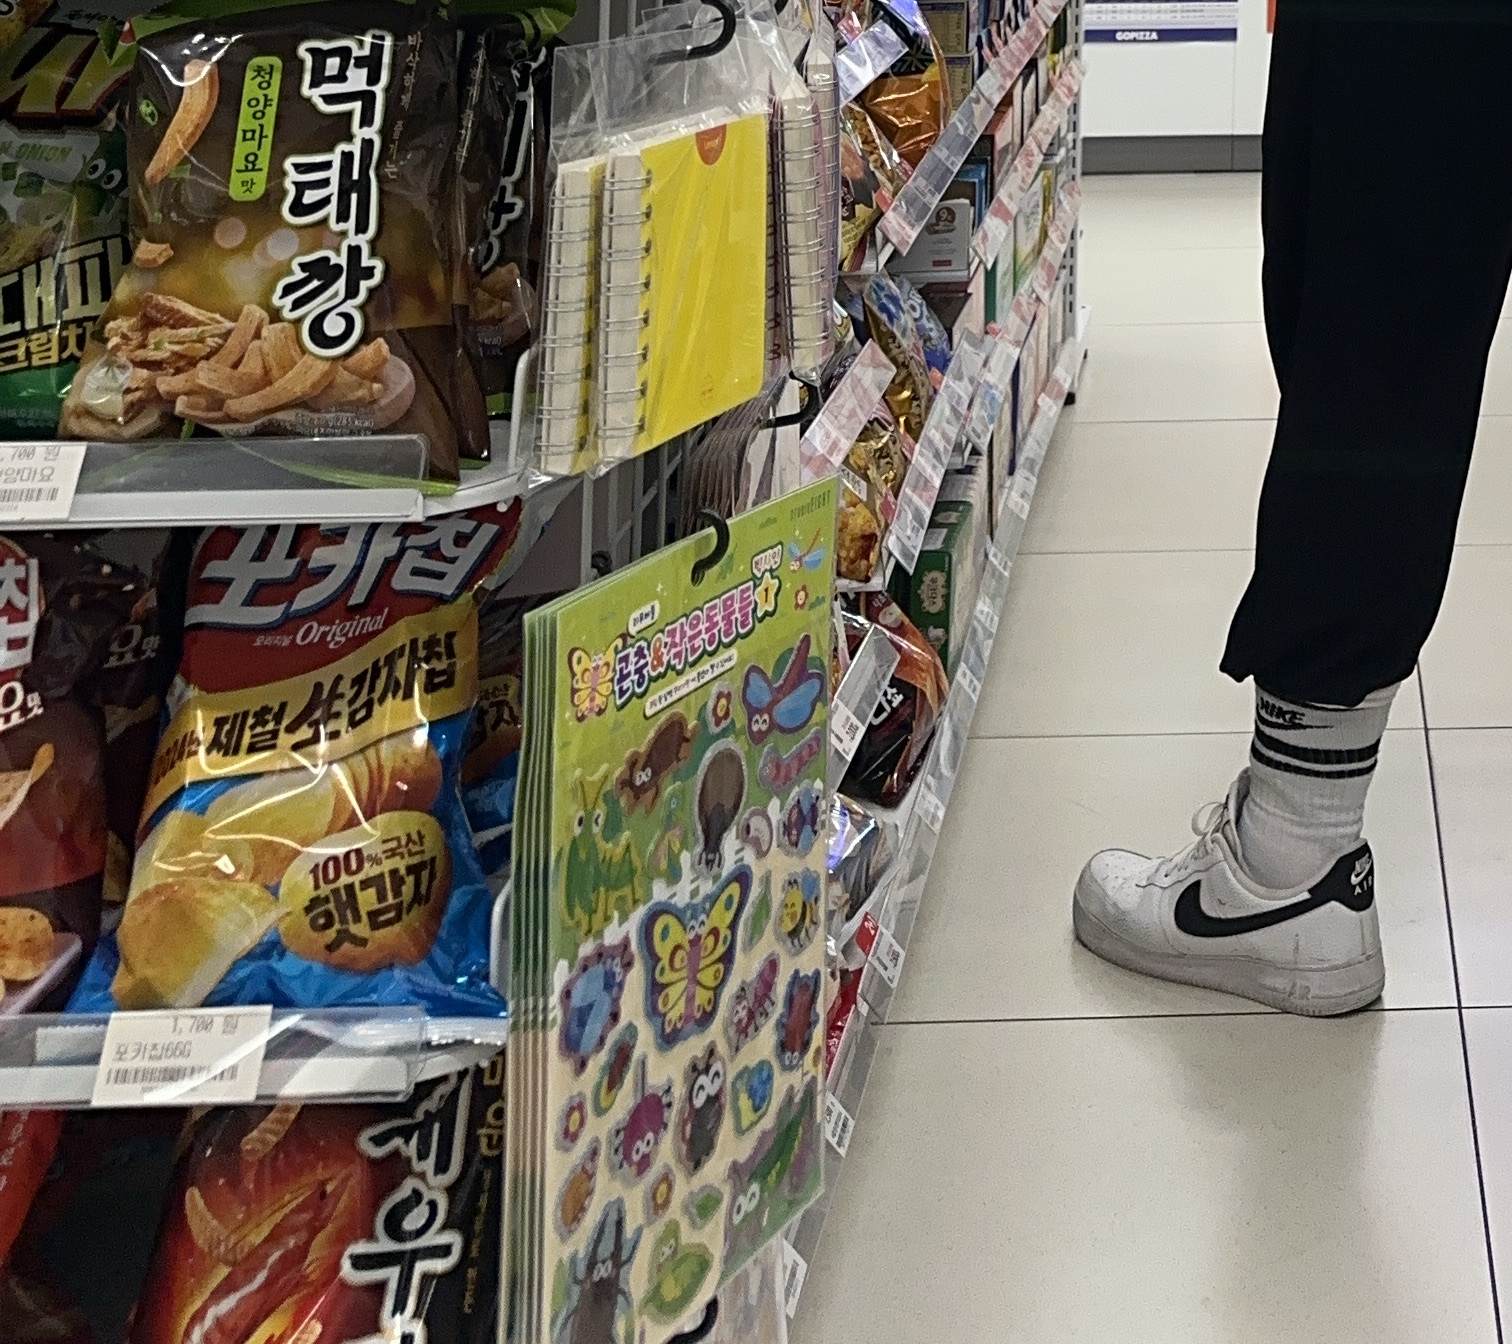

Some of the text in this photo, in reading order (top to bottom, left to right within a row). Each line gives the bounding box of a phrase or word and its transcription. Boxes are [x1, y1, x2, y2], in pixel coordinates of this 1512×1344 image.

[1115, 31, 1159, 41] GOPIZZA
[235, 63, 278, 194] 청양마요맛
[276, 30, 395, 357] 먹태깡
[296, 607, 390, 649] Original
[206, 702, 289, 757] 제철
[308, 830, 428, 889] 100% 국산
[303, 856, 438, 953] 햇감자
